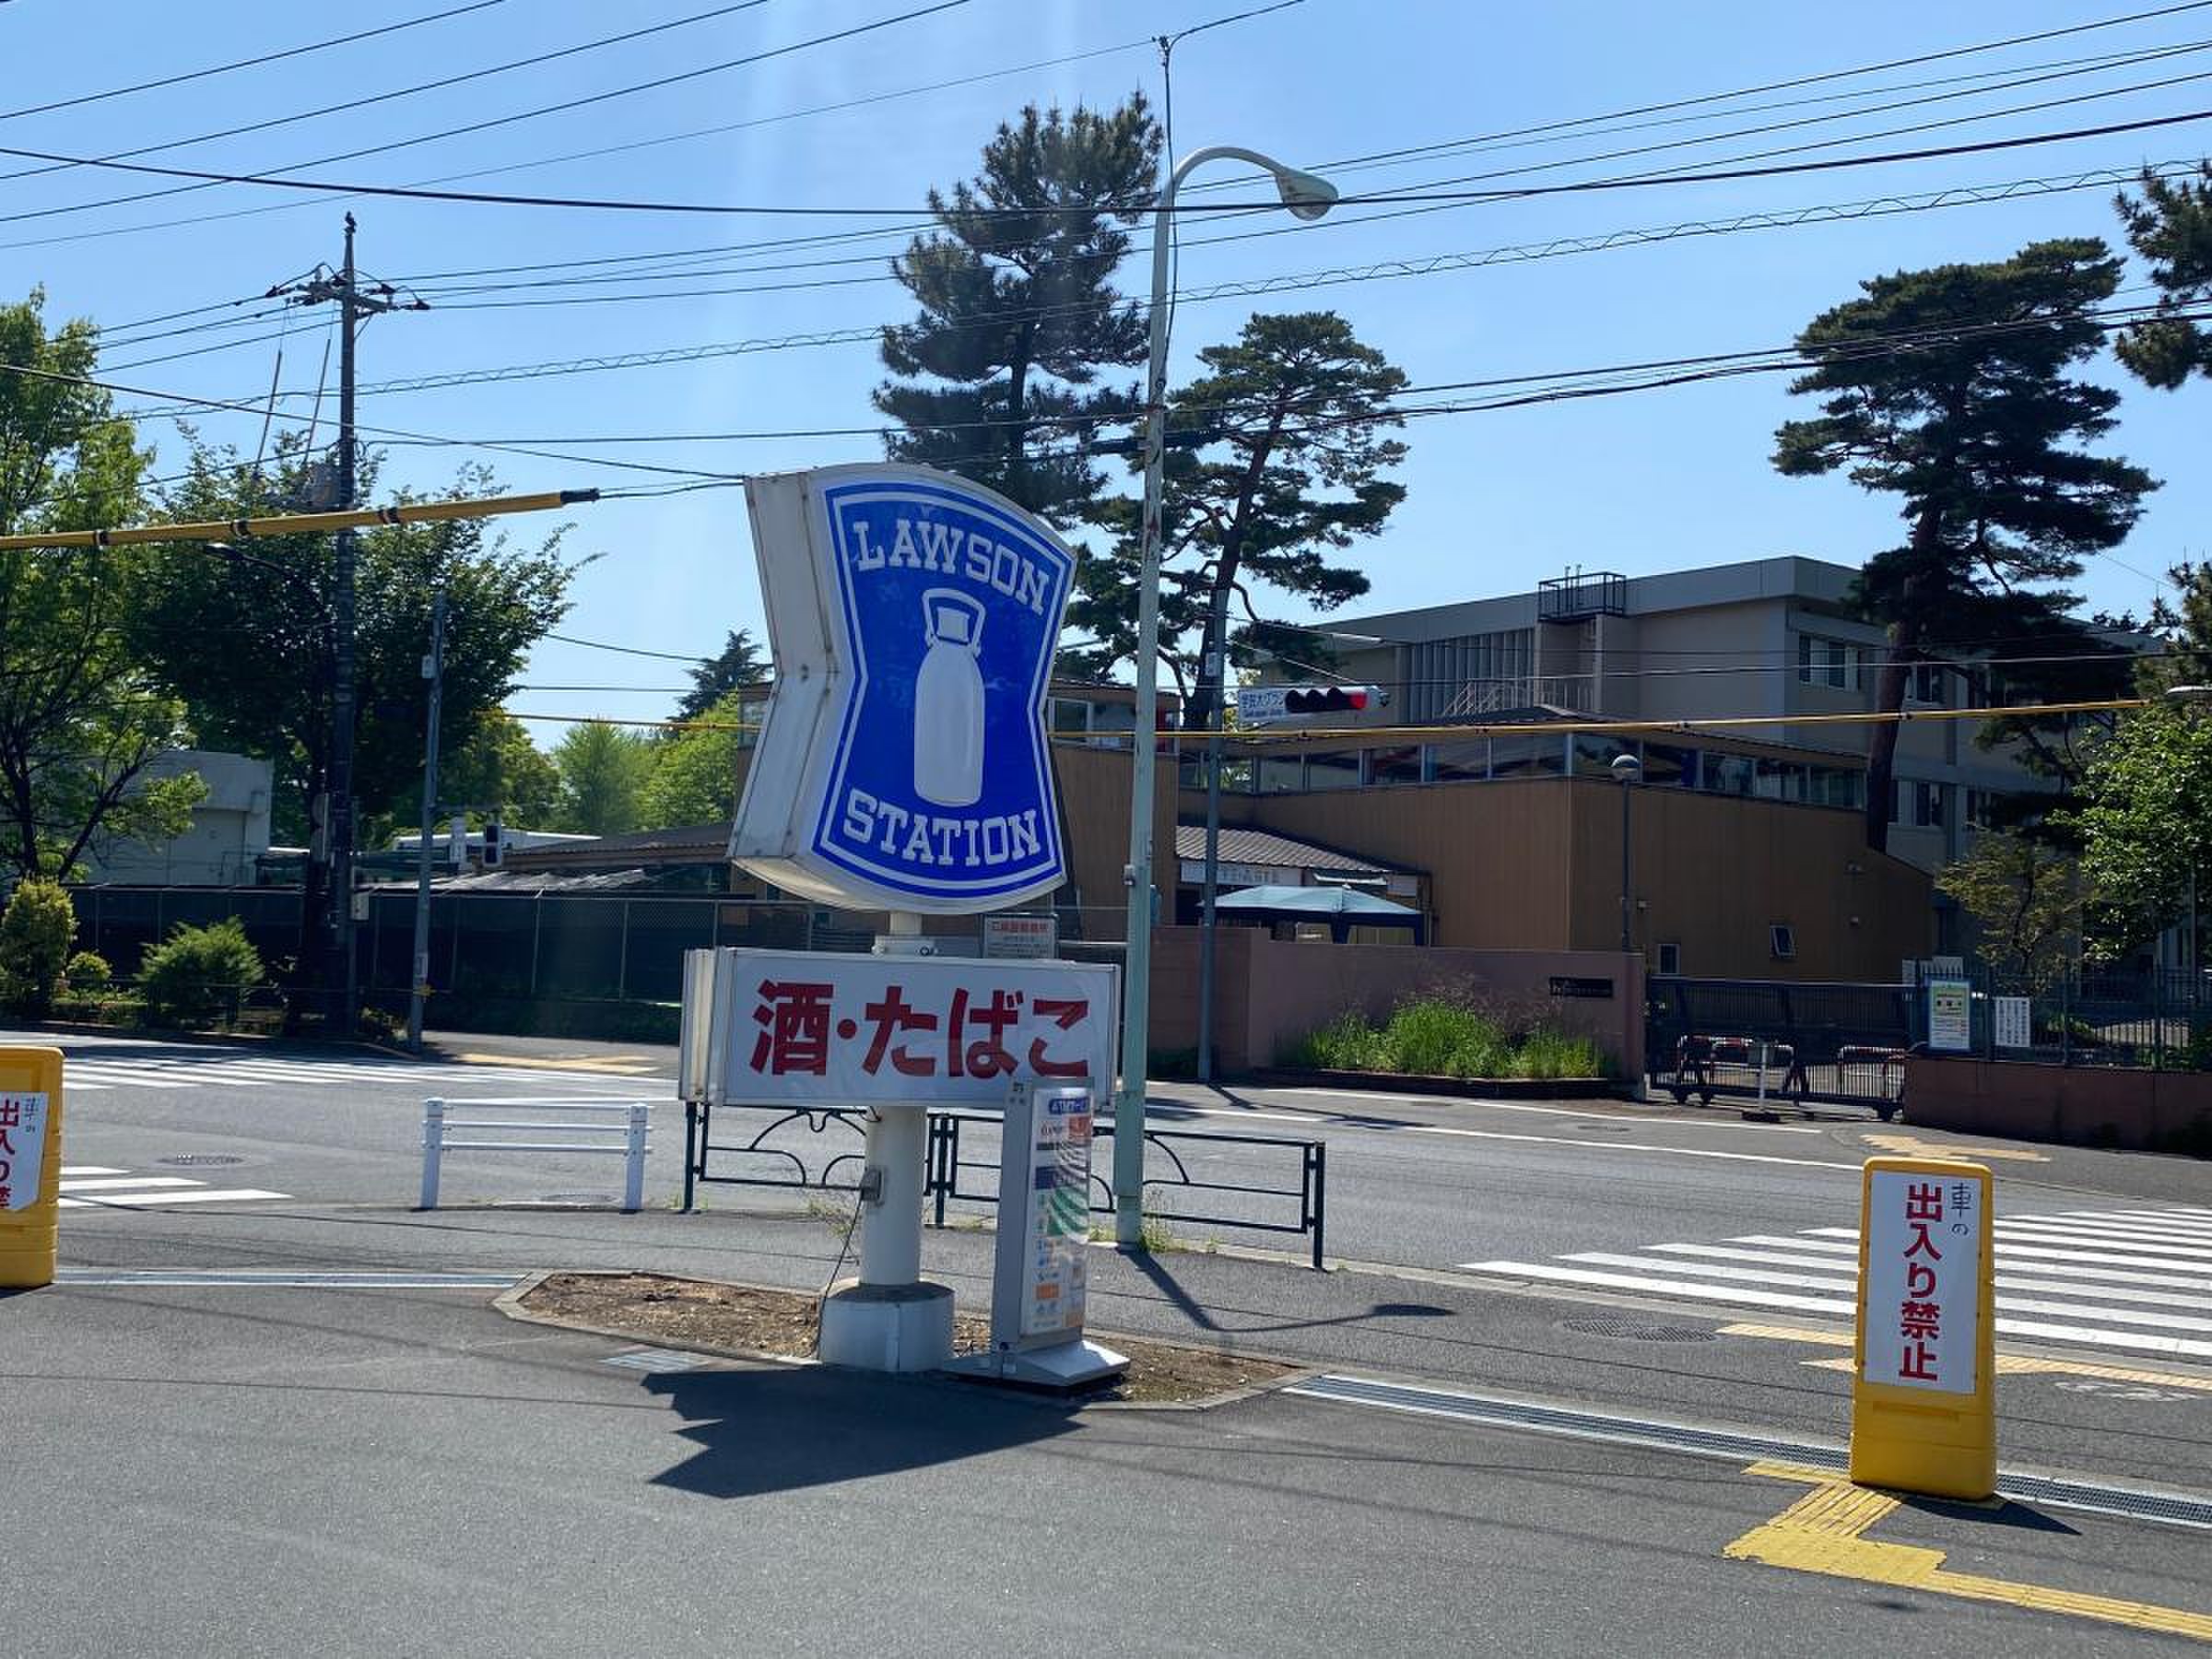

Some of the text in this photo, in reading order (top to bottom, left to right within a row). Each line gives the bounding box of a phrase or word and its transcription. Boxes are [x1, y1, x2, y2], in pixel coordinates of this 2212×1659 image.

[853, 519, 1050, 616] LAWSON
[844, 788, 1041, 866] STATION
[749, 979, 1089, 1079] 酒・たばこ
[1950, 1182, 1972, 1237] 車の
[1899, 1182, 1944, 1382] 出入り禁止
